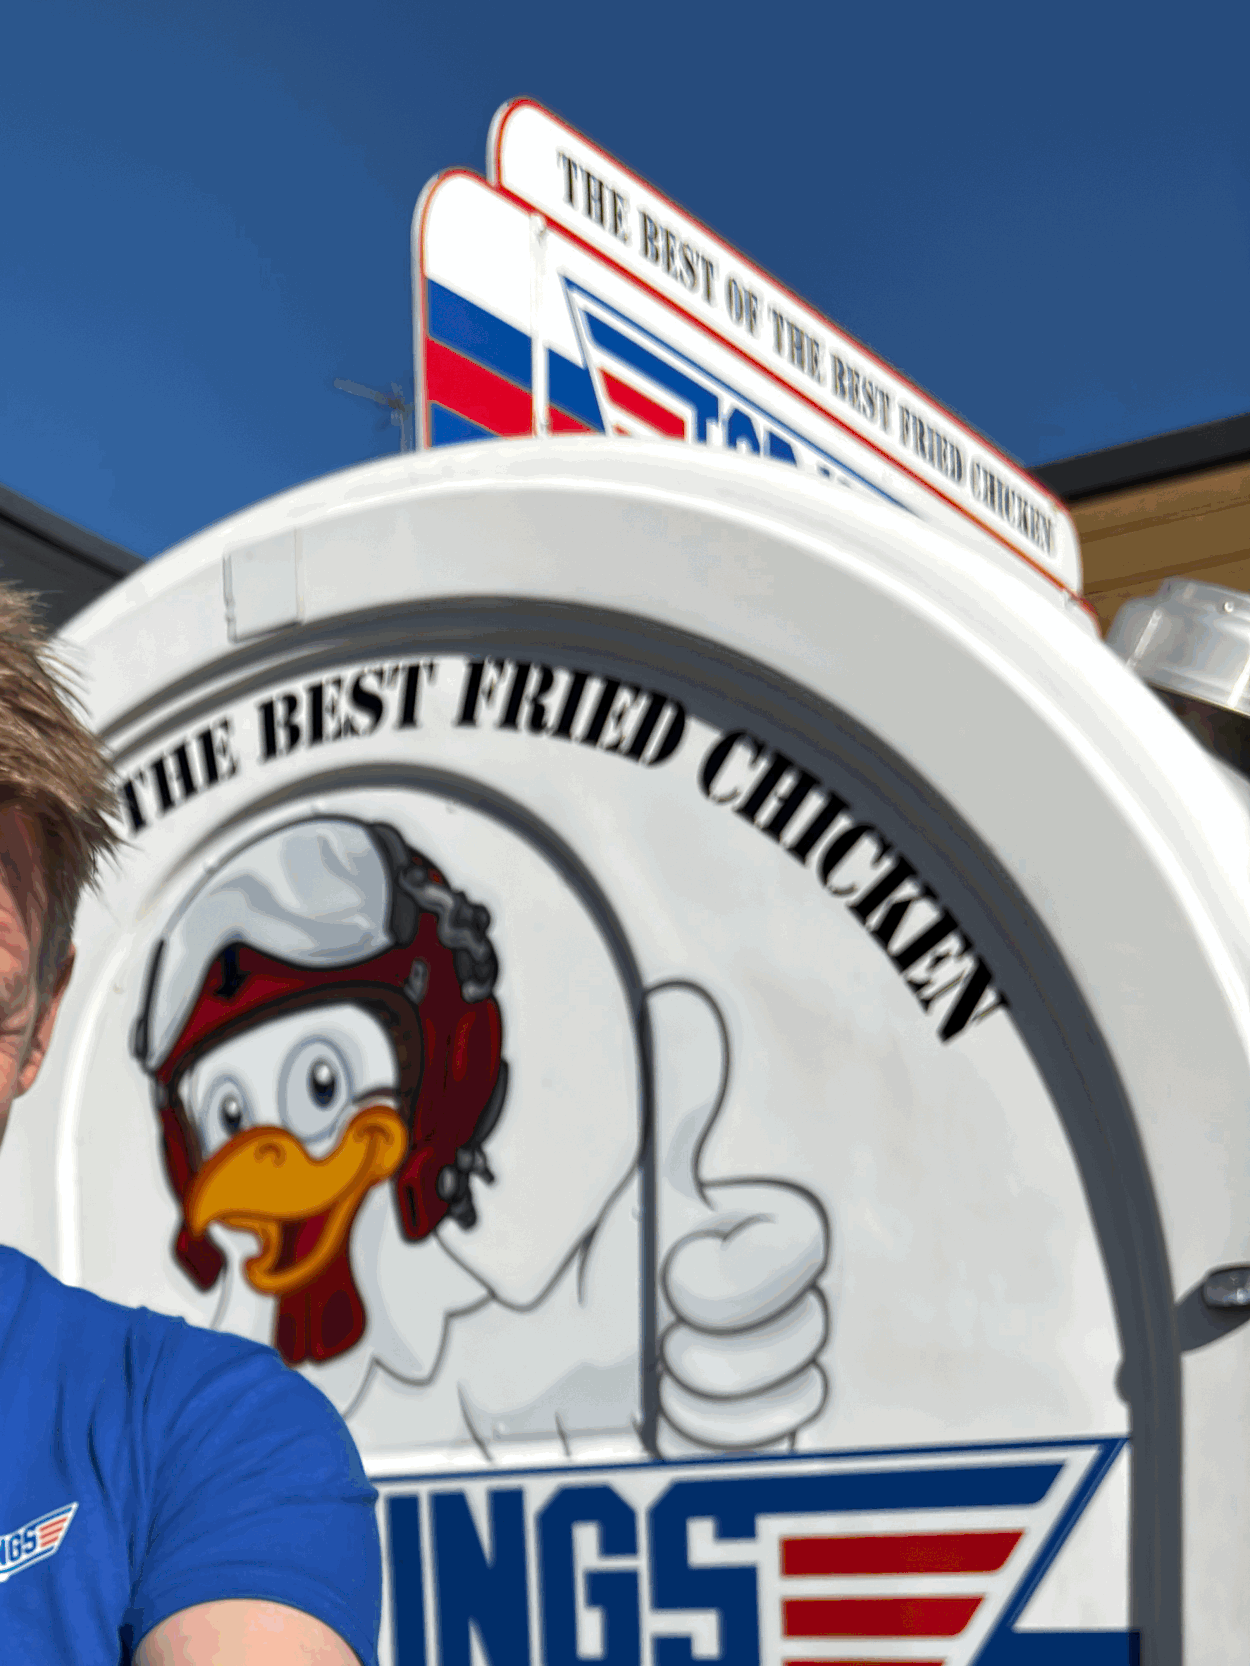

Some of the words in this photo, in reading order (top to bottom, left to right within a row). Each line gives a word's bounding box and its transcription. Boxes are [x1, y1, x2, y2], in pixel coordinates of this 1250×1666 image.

[557, 150, 629, 244] THE
[639, 208, 717, 306] BEST
[727, 275, 759, 336] OF
[769, 306, 823, 386] THE
[831, 353, 894, 432] BEST
[900, 402, 964, 484] FRIED
[970, 459, 1053, 555] CHICKEN
[120, 717, 238, 836] THE
[258, 661, 438, 765] BEST
[456, 658, 687, 768] FRIED
[697, 727, 1011, 1045] CHICKEN
